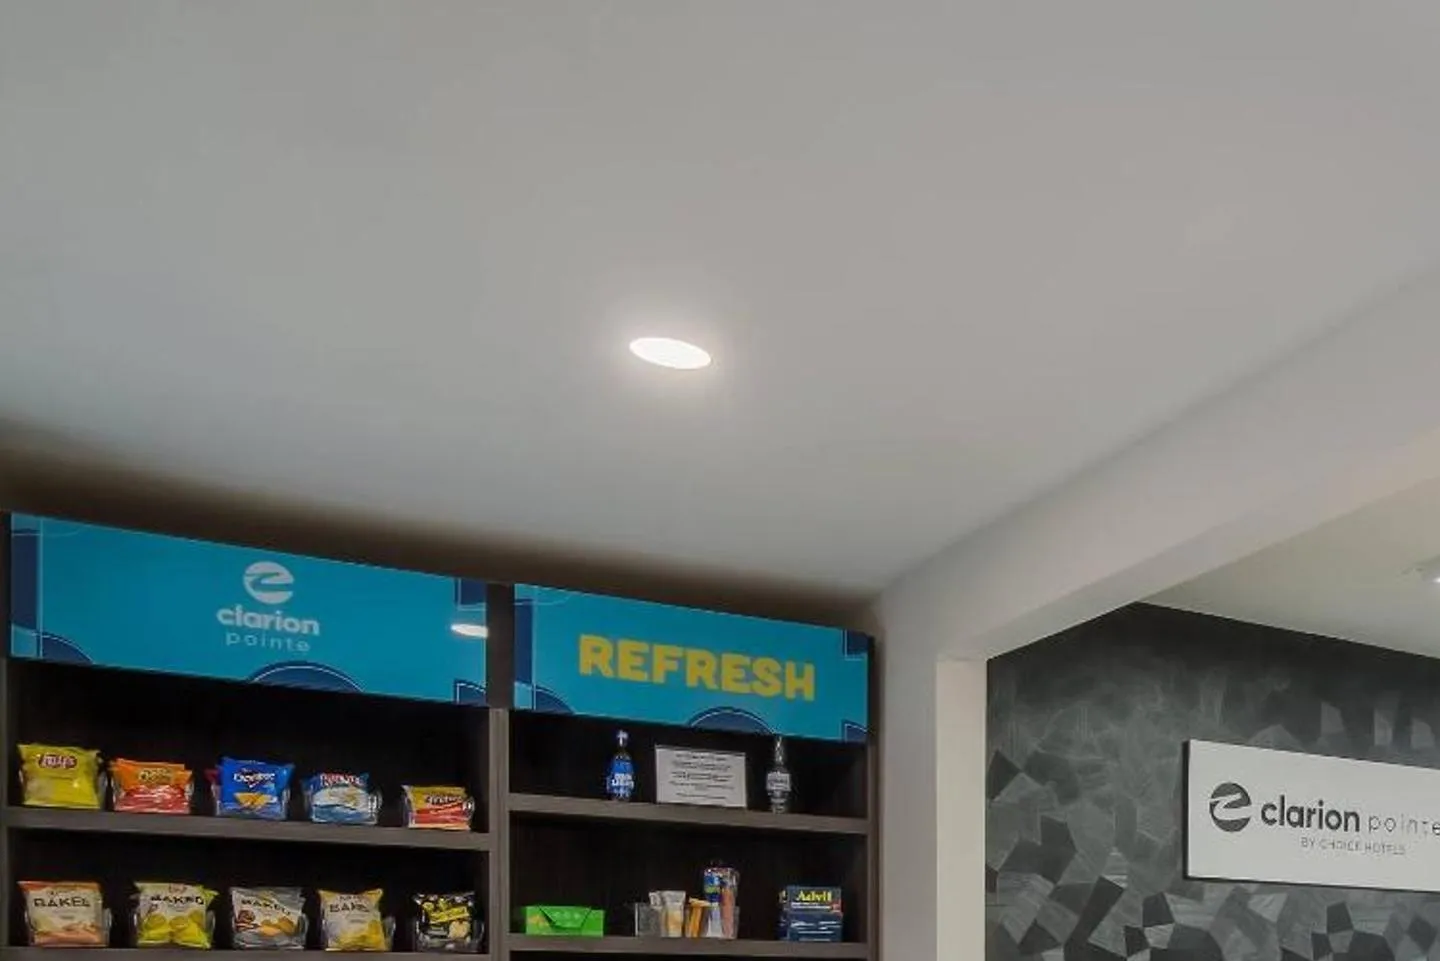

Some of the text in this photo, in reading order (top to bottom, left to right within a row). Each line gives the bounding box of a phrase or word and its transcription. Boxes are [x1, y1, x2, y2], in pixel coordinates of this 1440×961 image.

[216, 604, 319, 636] clarion
[225, 632, 310, 653] pointe
[578, 633, 815, 701] REFRESH
[1260, 795, 1361, 833] clarion
[1301, 836, 1407, 856] BY CHOICE HOTELS
[796, 889, 832, 902] Advil
